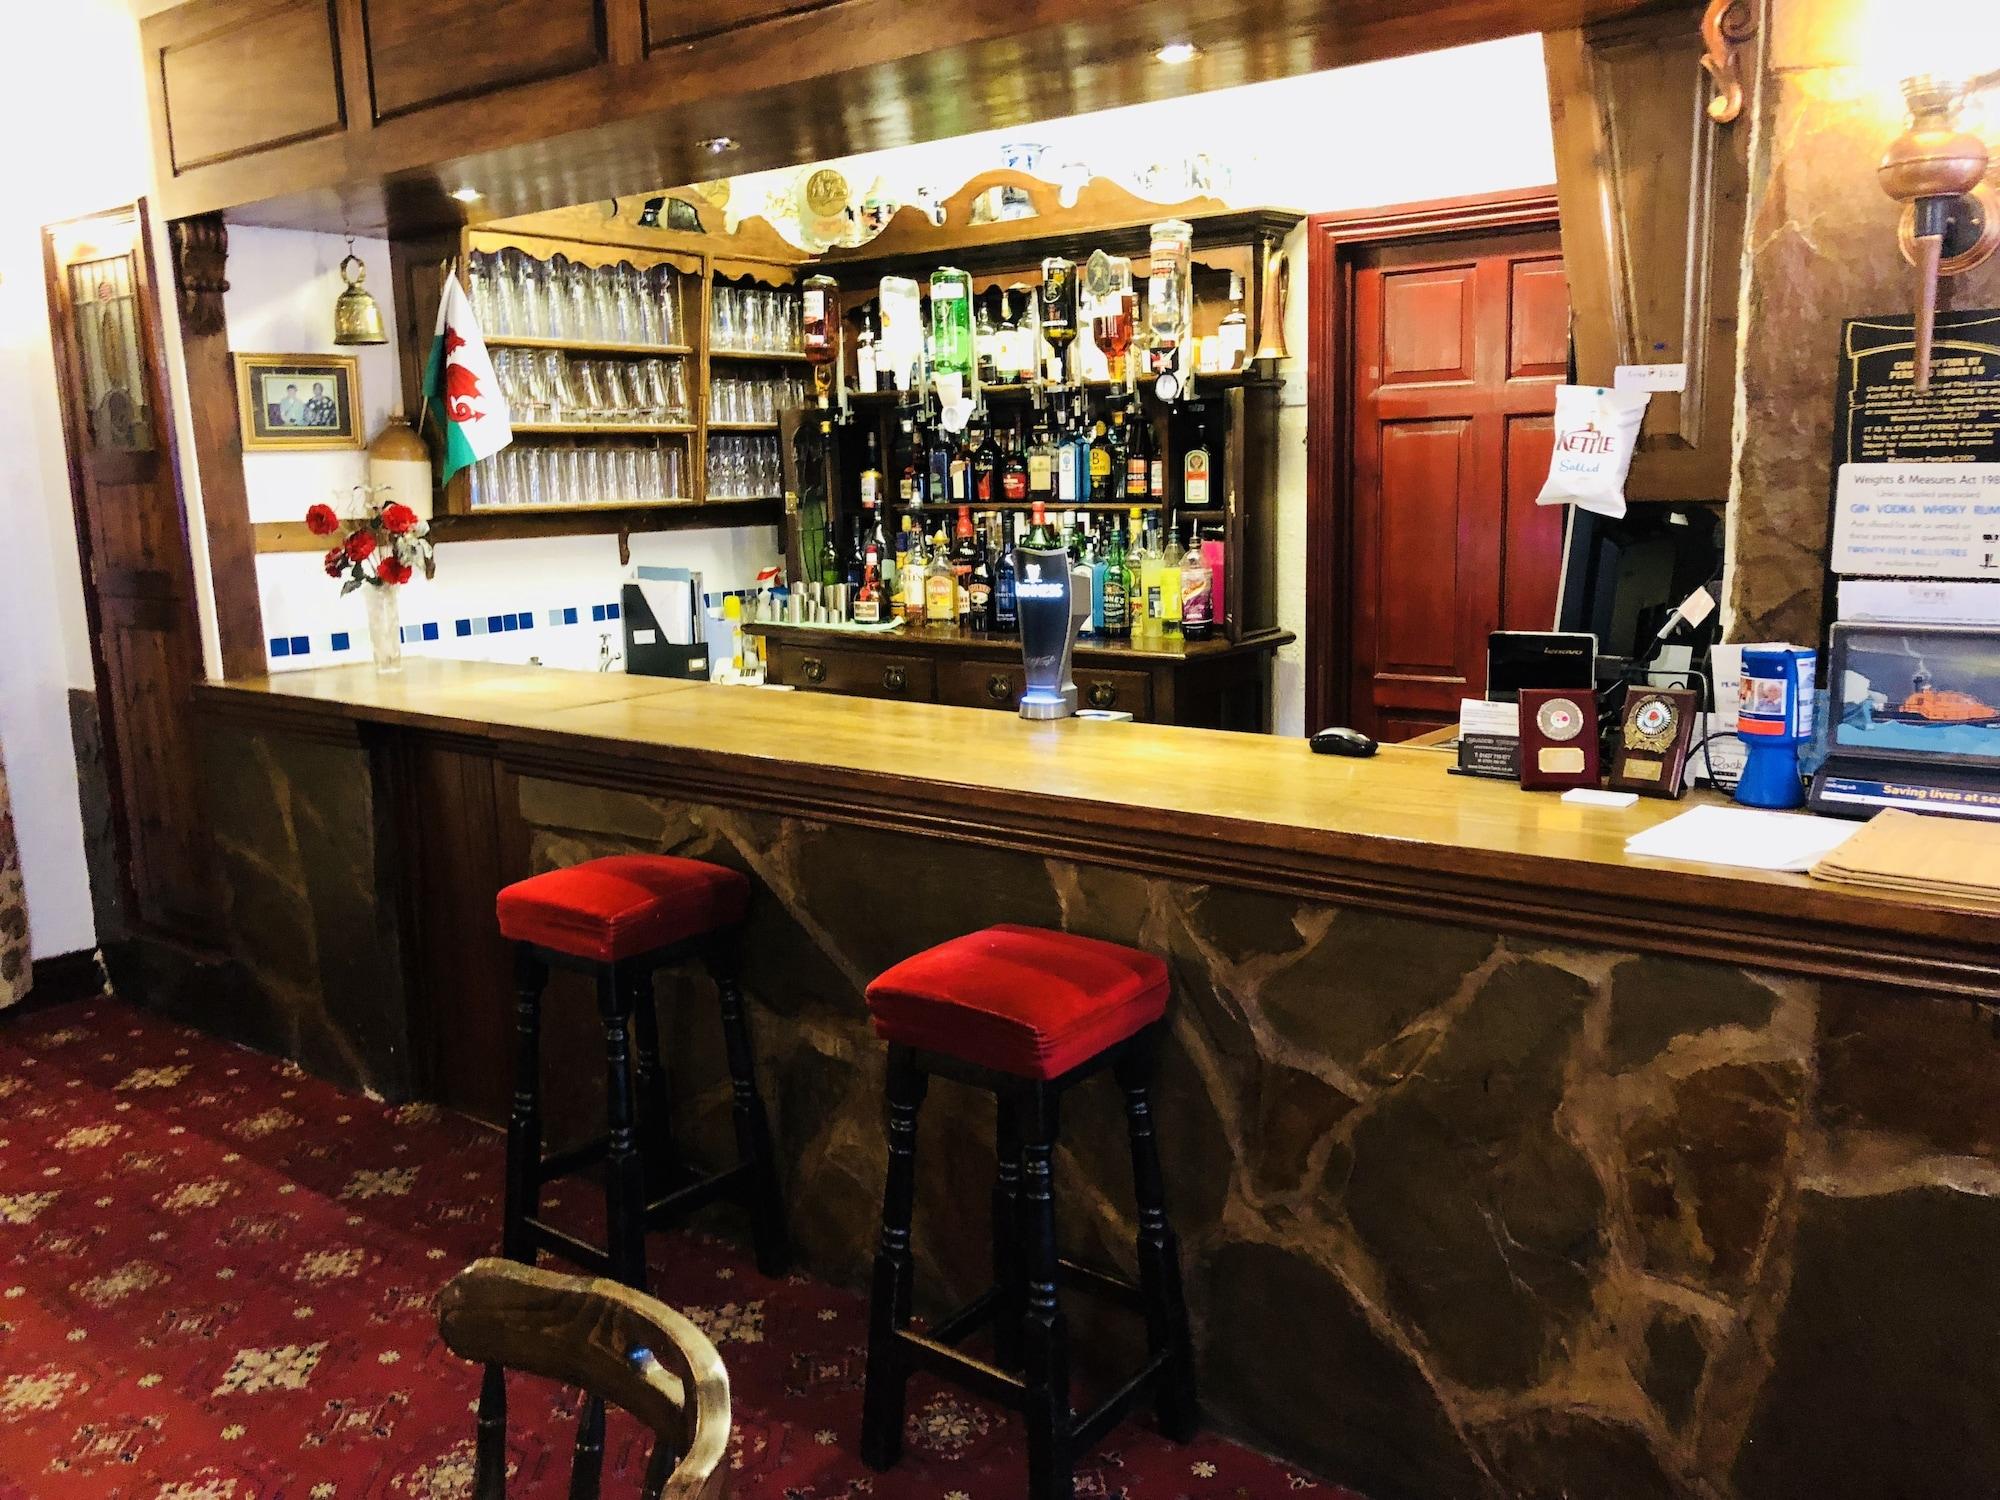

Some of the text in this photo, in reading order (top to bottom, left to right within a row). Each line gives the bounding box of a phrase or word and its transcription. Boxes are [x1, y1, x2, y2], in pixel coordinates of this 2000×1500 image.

[1556, 429, 1616, 454] KETTLE
[1559, 459, 1601, 472] Salted
[1854, 474, 1895, 487] Weights
[1896, 474, 1906, 485] &
[1908, 474, 1957, 485] Measures
[1959, 475, 1978, 485] Act
[1850, 503, 1871, 514] GIN
[1876, 503, 1917, 514] VODKA
[1922, 504, 1967, 515] WHISKY
[1883, 784, 1927, 799] Saving
[1929, 788, 1962, 801] lives
[1964, 793, 1978, 803] at
